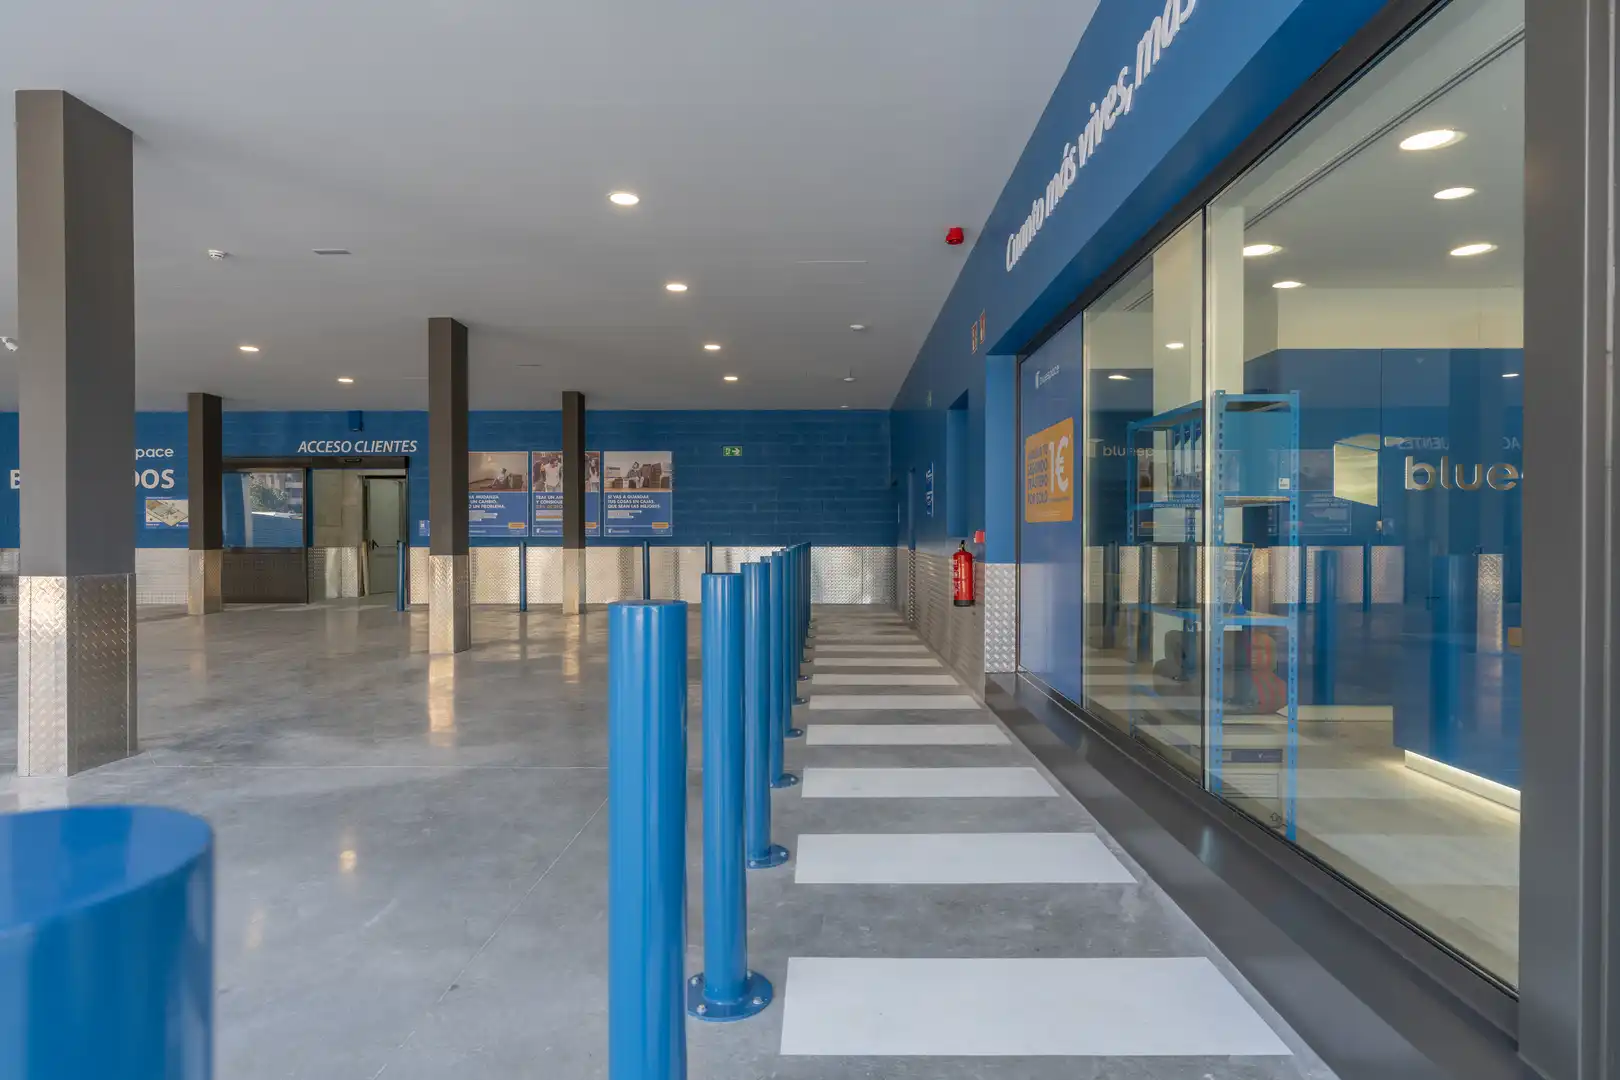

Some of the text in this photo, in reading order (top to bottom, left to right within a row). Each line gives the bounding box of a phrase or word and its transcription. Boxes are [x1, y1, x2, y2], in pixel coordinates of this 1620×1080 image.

[1006, 198, 1044, 272] Cuanto
[1045, 143, 1077, 218] más
[1078, 66, 1133, 168] vives,
[135, 448, 175, 461] pace
[297, 440, 417, 453] ACCESO CLIENTES
[1405, 455, 1524, 491] blue
